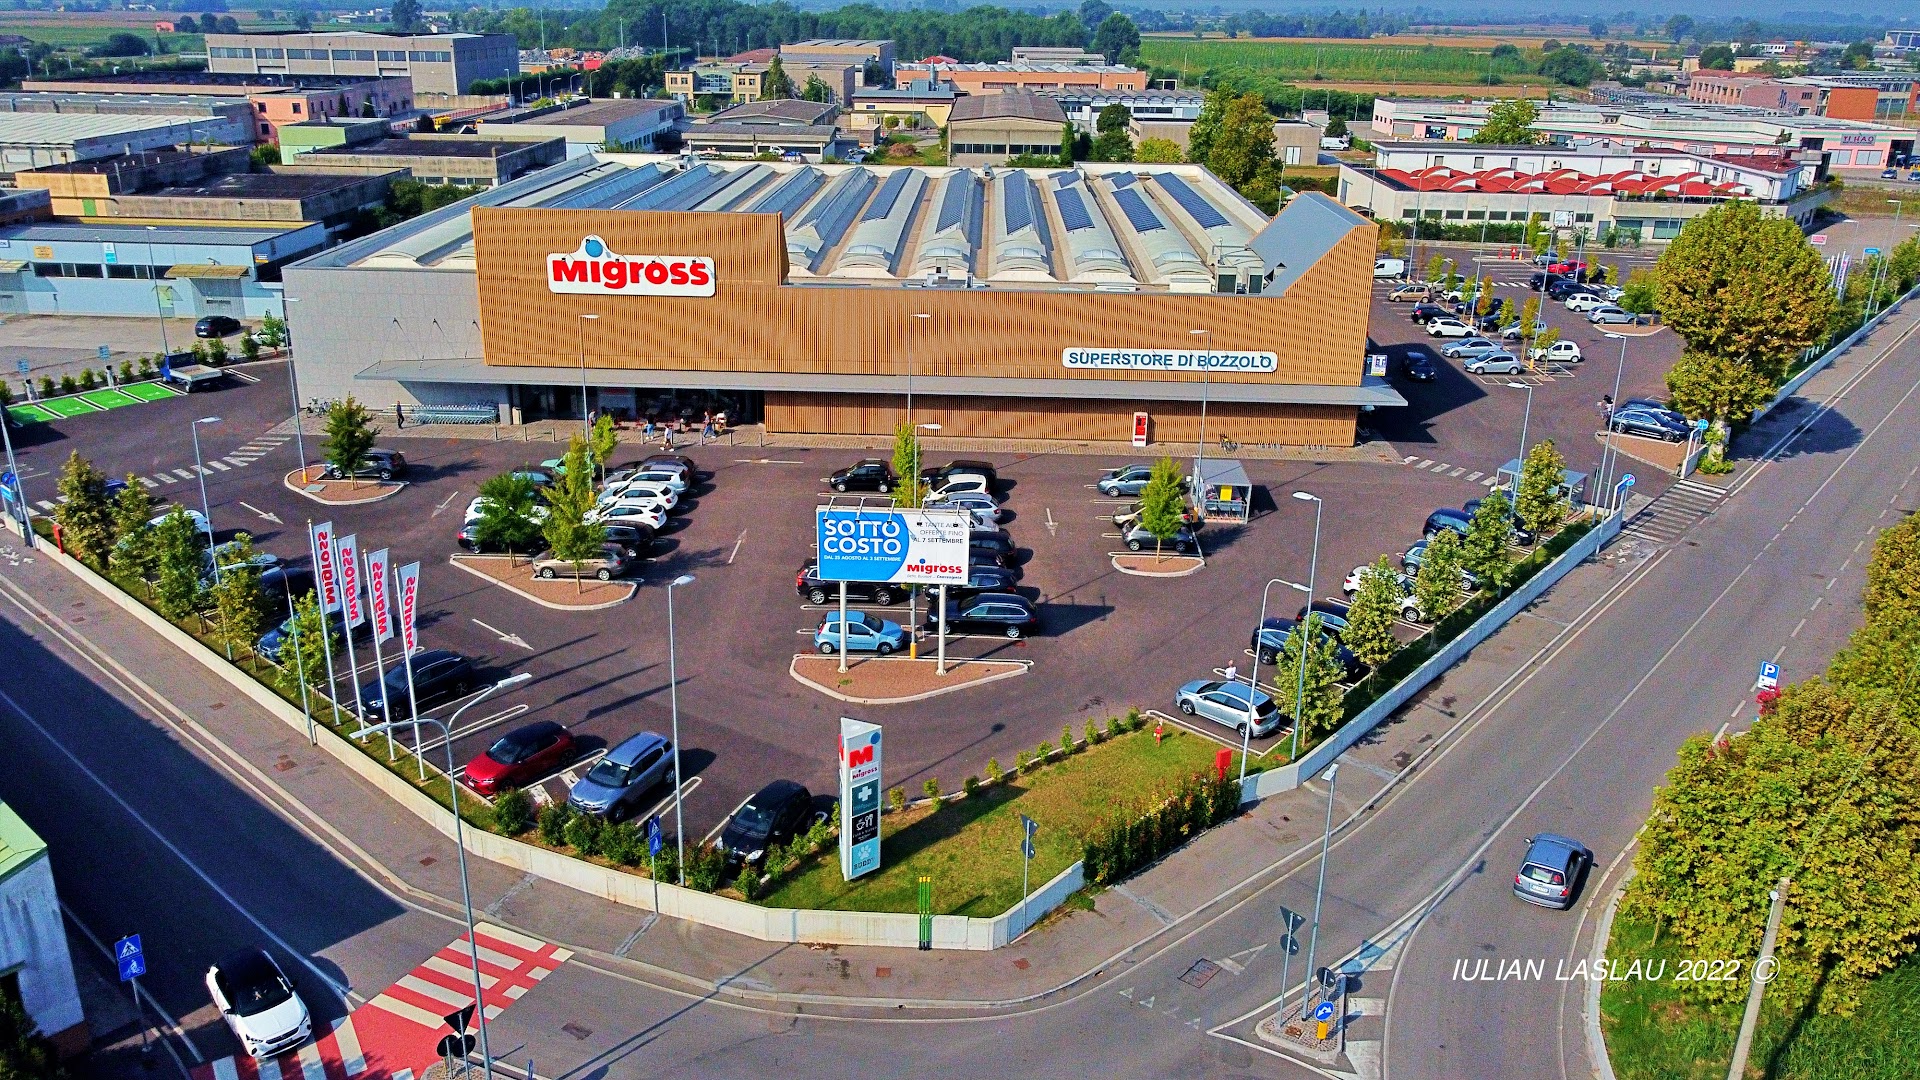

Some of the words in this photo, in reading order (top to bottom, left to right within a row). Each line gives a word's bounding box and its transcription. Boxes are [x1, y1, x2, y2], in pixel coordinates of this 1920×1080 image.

[552, 260, 710, 289] Migross
[1068, 352, 1174, 367] SUPERSTORE
[1178, 354, 1193, 367] DI
[1197, 354, 1272, 368] BOZZOLO
[824, 519, 900, 538] SOTTO
[823, 537, 902, 554] COSTO
[907, 564, 962, 574] Migross
[1764, 664, 1776, 676] P
[849, 745, 874, 768] M
[852, 767, 878, 780] Migross
